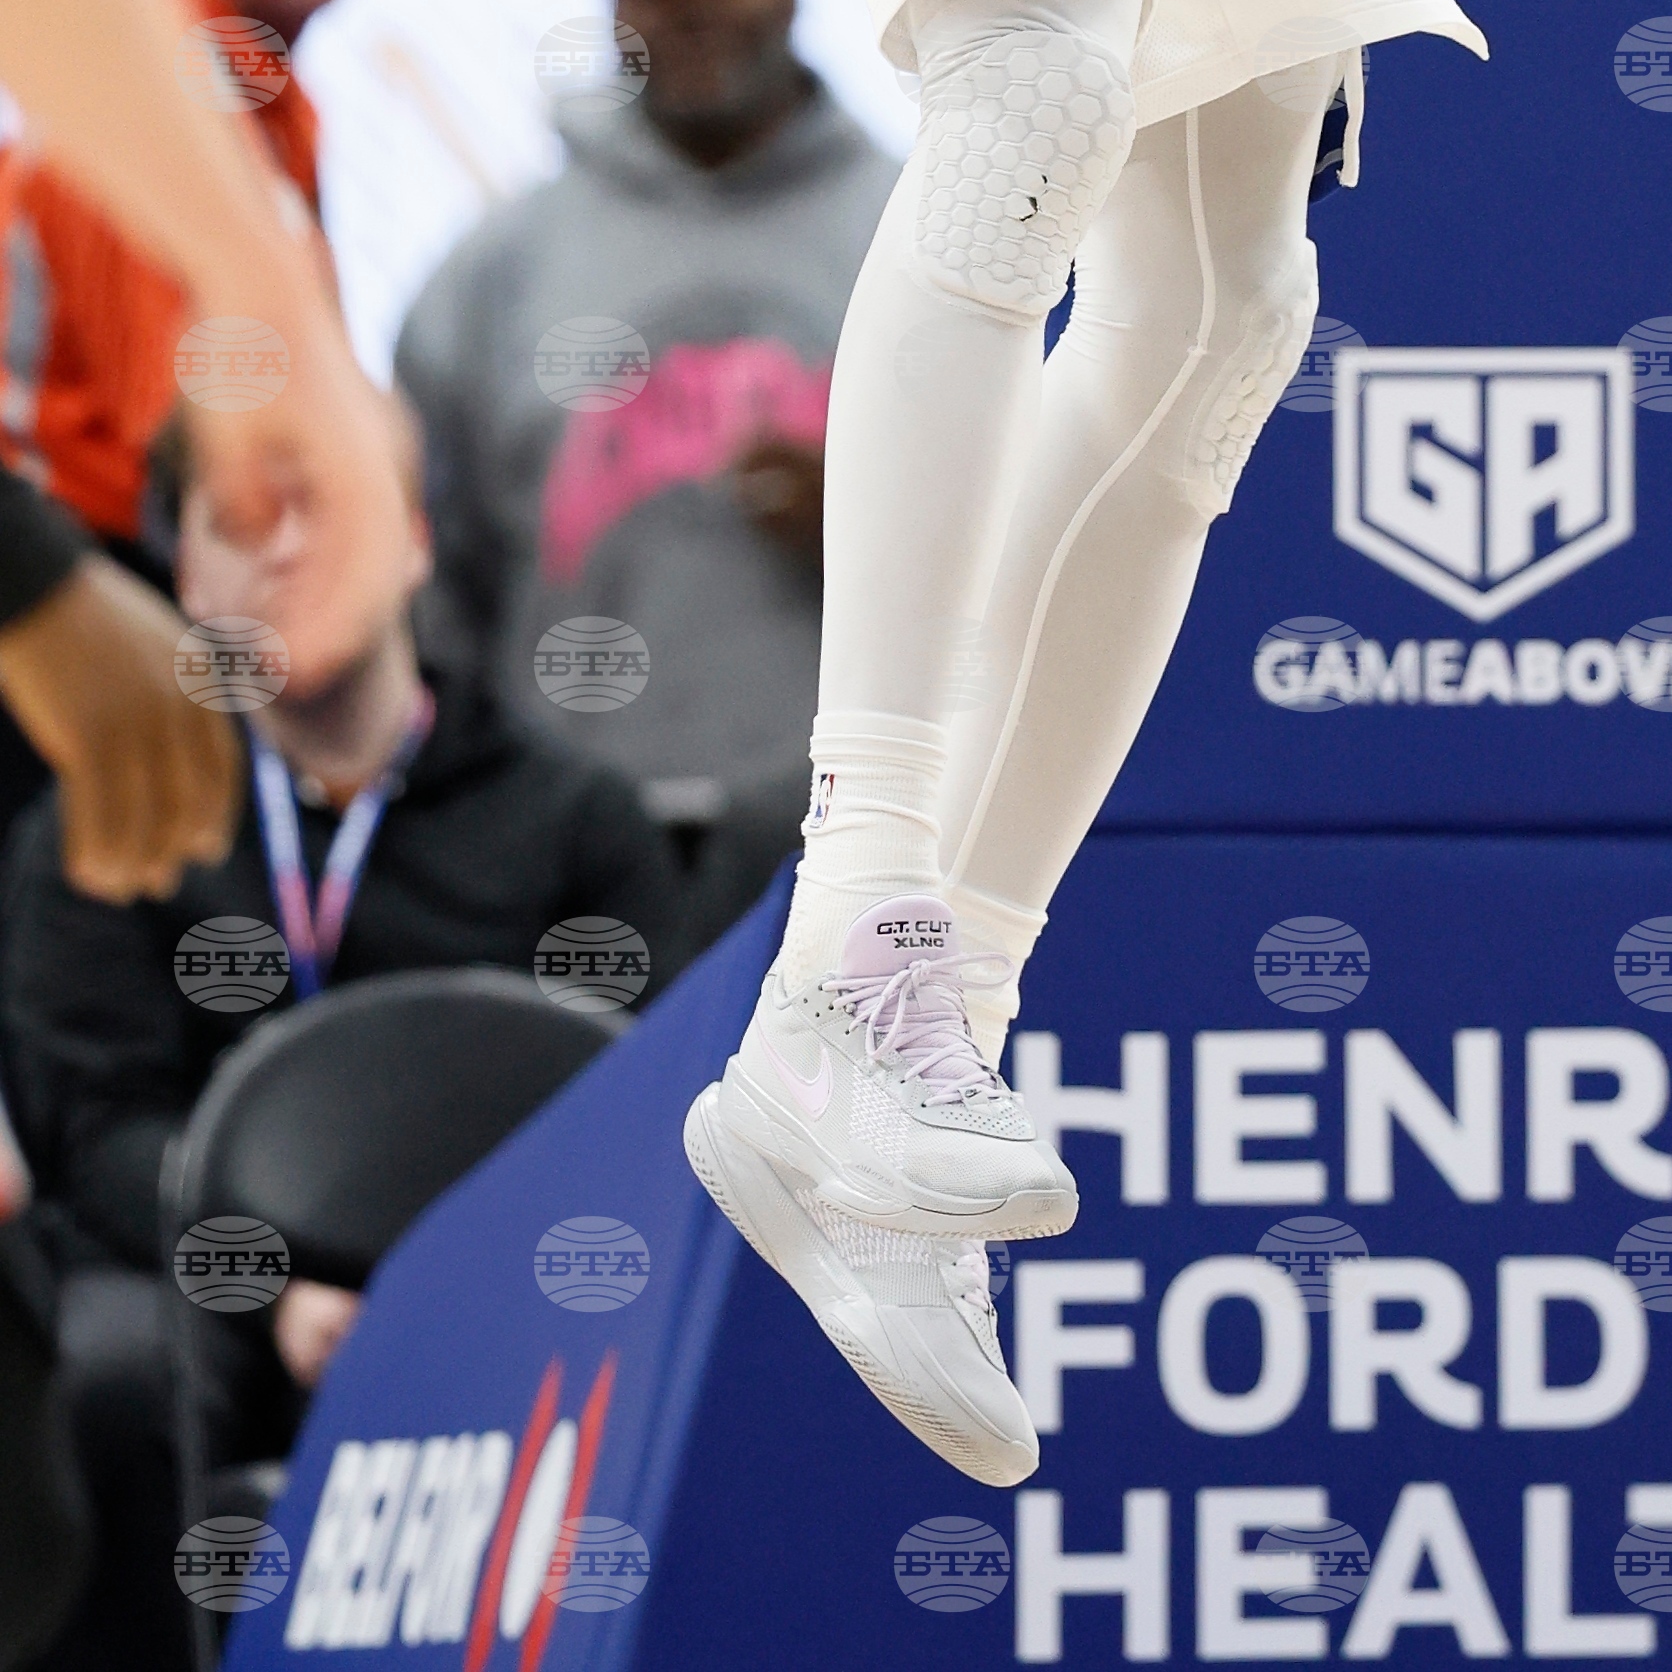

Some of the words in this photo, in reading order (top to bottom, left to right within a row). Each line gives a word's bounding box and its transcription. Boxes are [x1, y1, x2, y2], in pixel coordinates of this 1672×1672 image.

[1360, 374, 1603, 582] GA
[877, 920, 910, 935] G.T.
[914, 920, 953, 934] CUT
[1013, 1255, 1650, 1436] FORD
